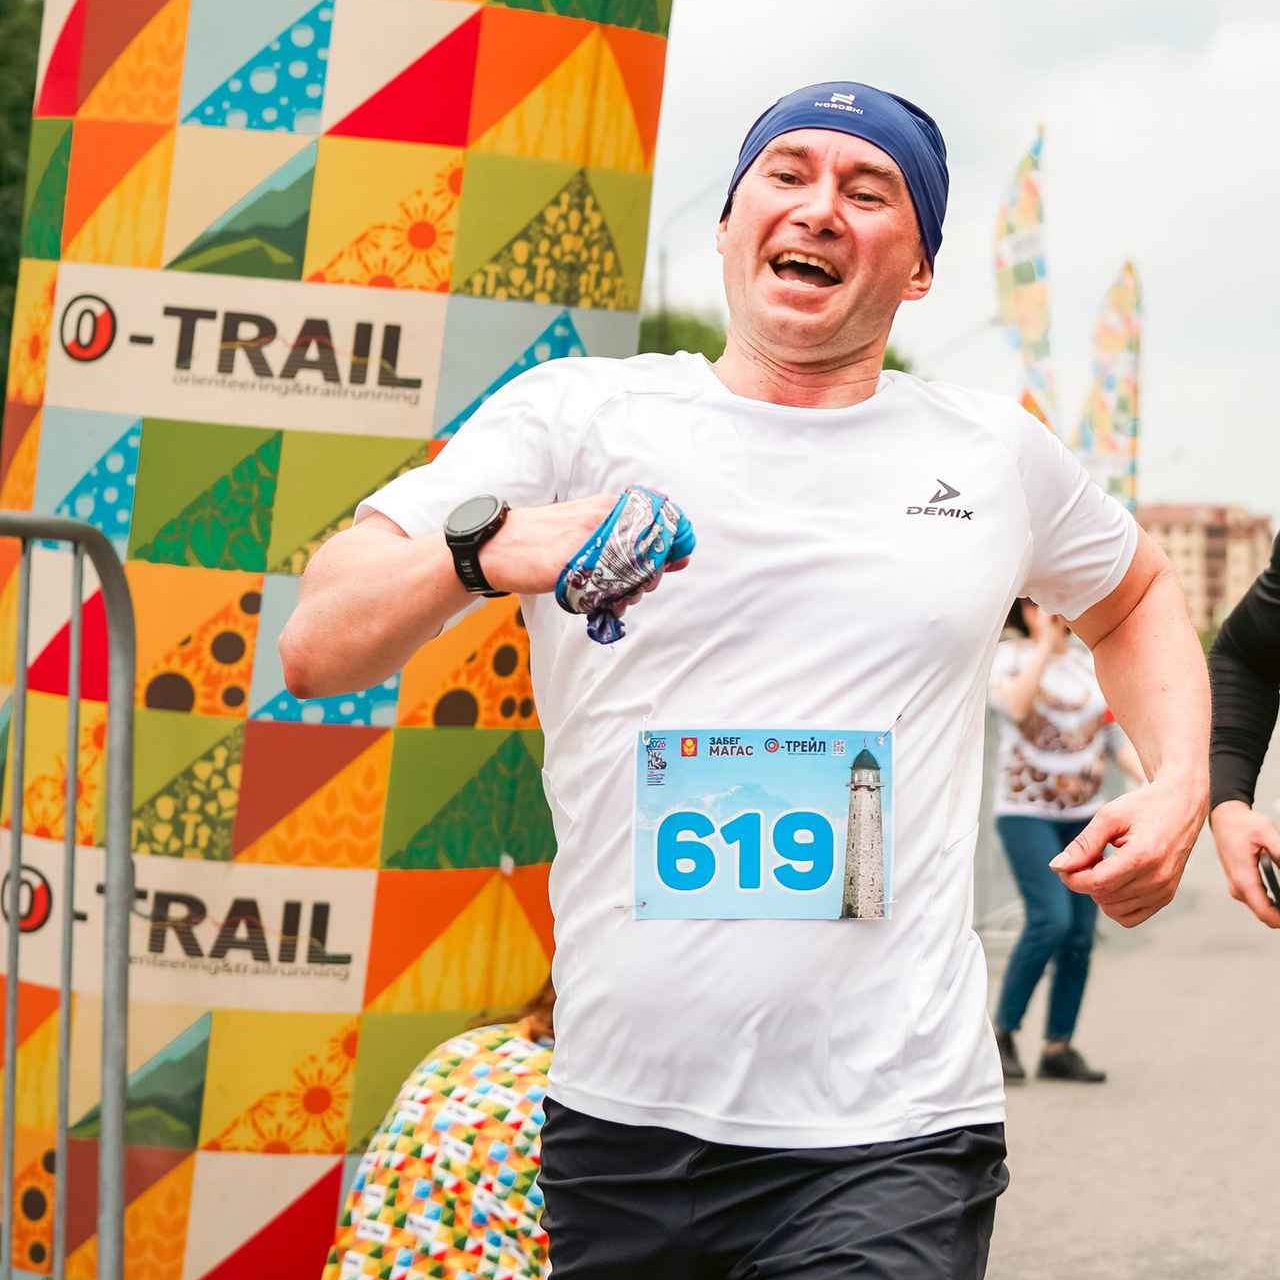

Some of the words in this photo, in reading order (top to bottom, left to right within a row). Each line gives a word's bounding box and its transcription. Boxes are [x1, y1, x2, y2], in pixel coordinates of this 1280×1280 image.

[814, 102, 864, 115] NORDSKI
[906, 506, 974, 521] DEMIX
[709, 737, 741, 745] ЗАБЕГ
[709, 746, 754, 756] МАГАС
[657, 811, 834, 891] 619
